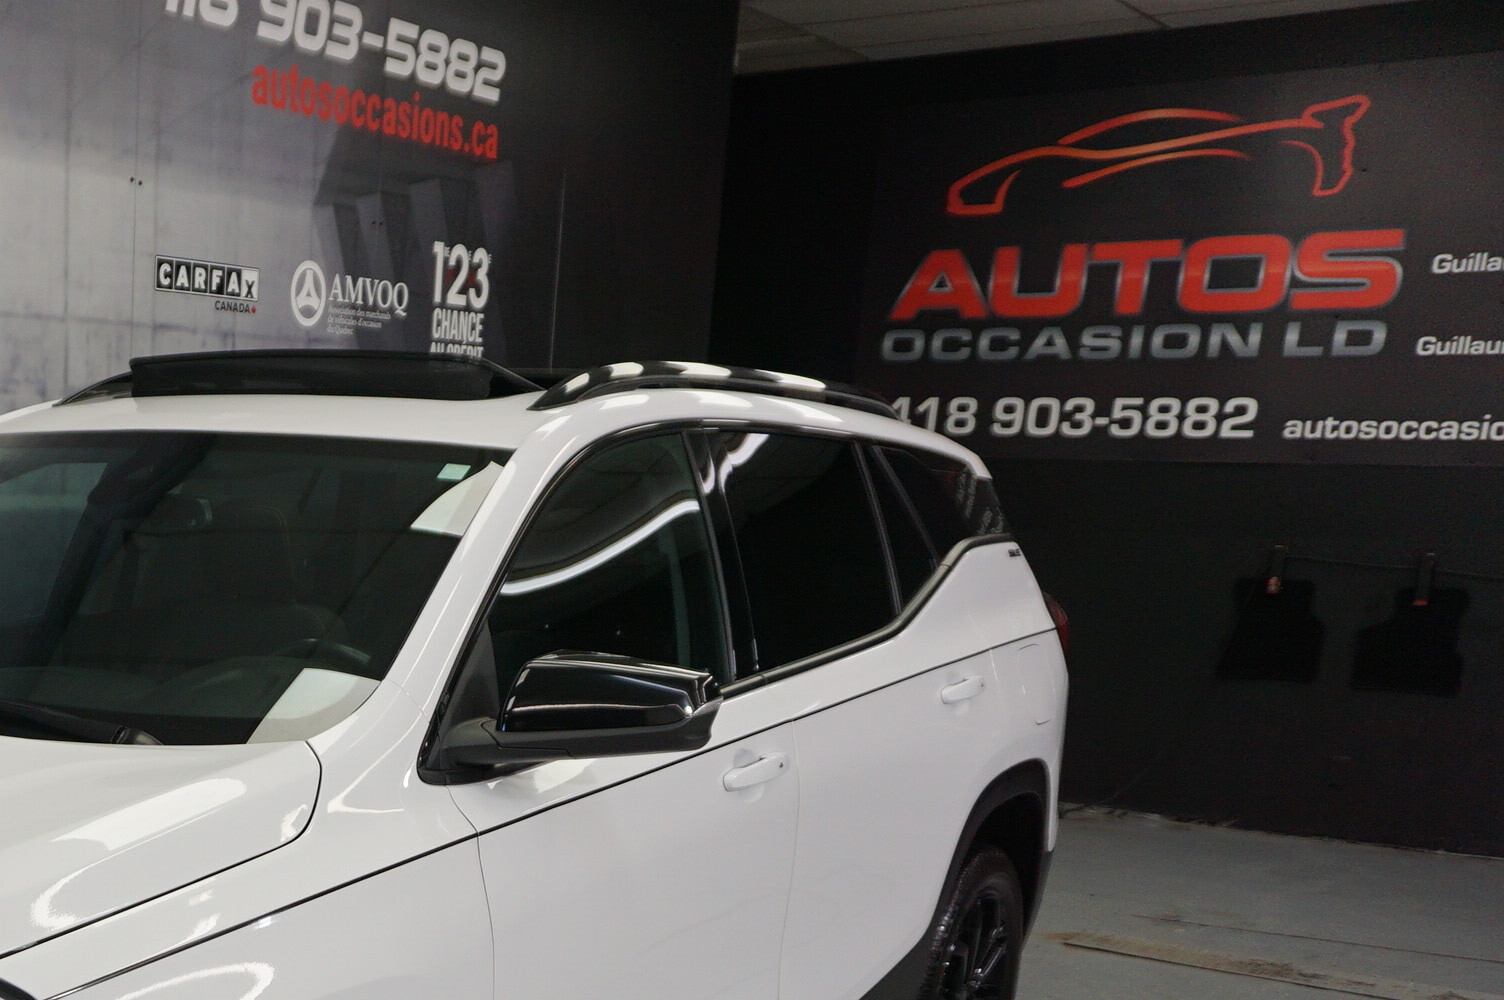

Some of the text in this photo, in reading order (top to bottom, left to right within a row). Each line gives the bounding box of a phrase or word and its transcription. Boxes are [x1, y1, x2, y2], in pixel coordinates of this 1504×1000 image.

[257, 0, 506, 102] 903-5882
[252, 64, 499, 159] autosoccasions.ca
[159, 262, 255, 298] CARFAX
[328, 273, 409, 317] AMVOQ
[890, 229, 1406, 321] AUTOS
[215, 300, 250, 313] CANADA
[432, 307, 485, 343] CHANCE
[882, 320, 1388, 362] OCCASION LD
[990, 396, 1259, 440] 903-5882
